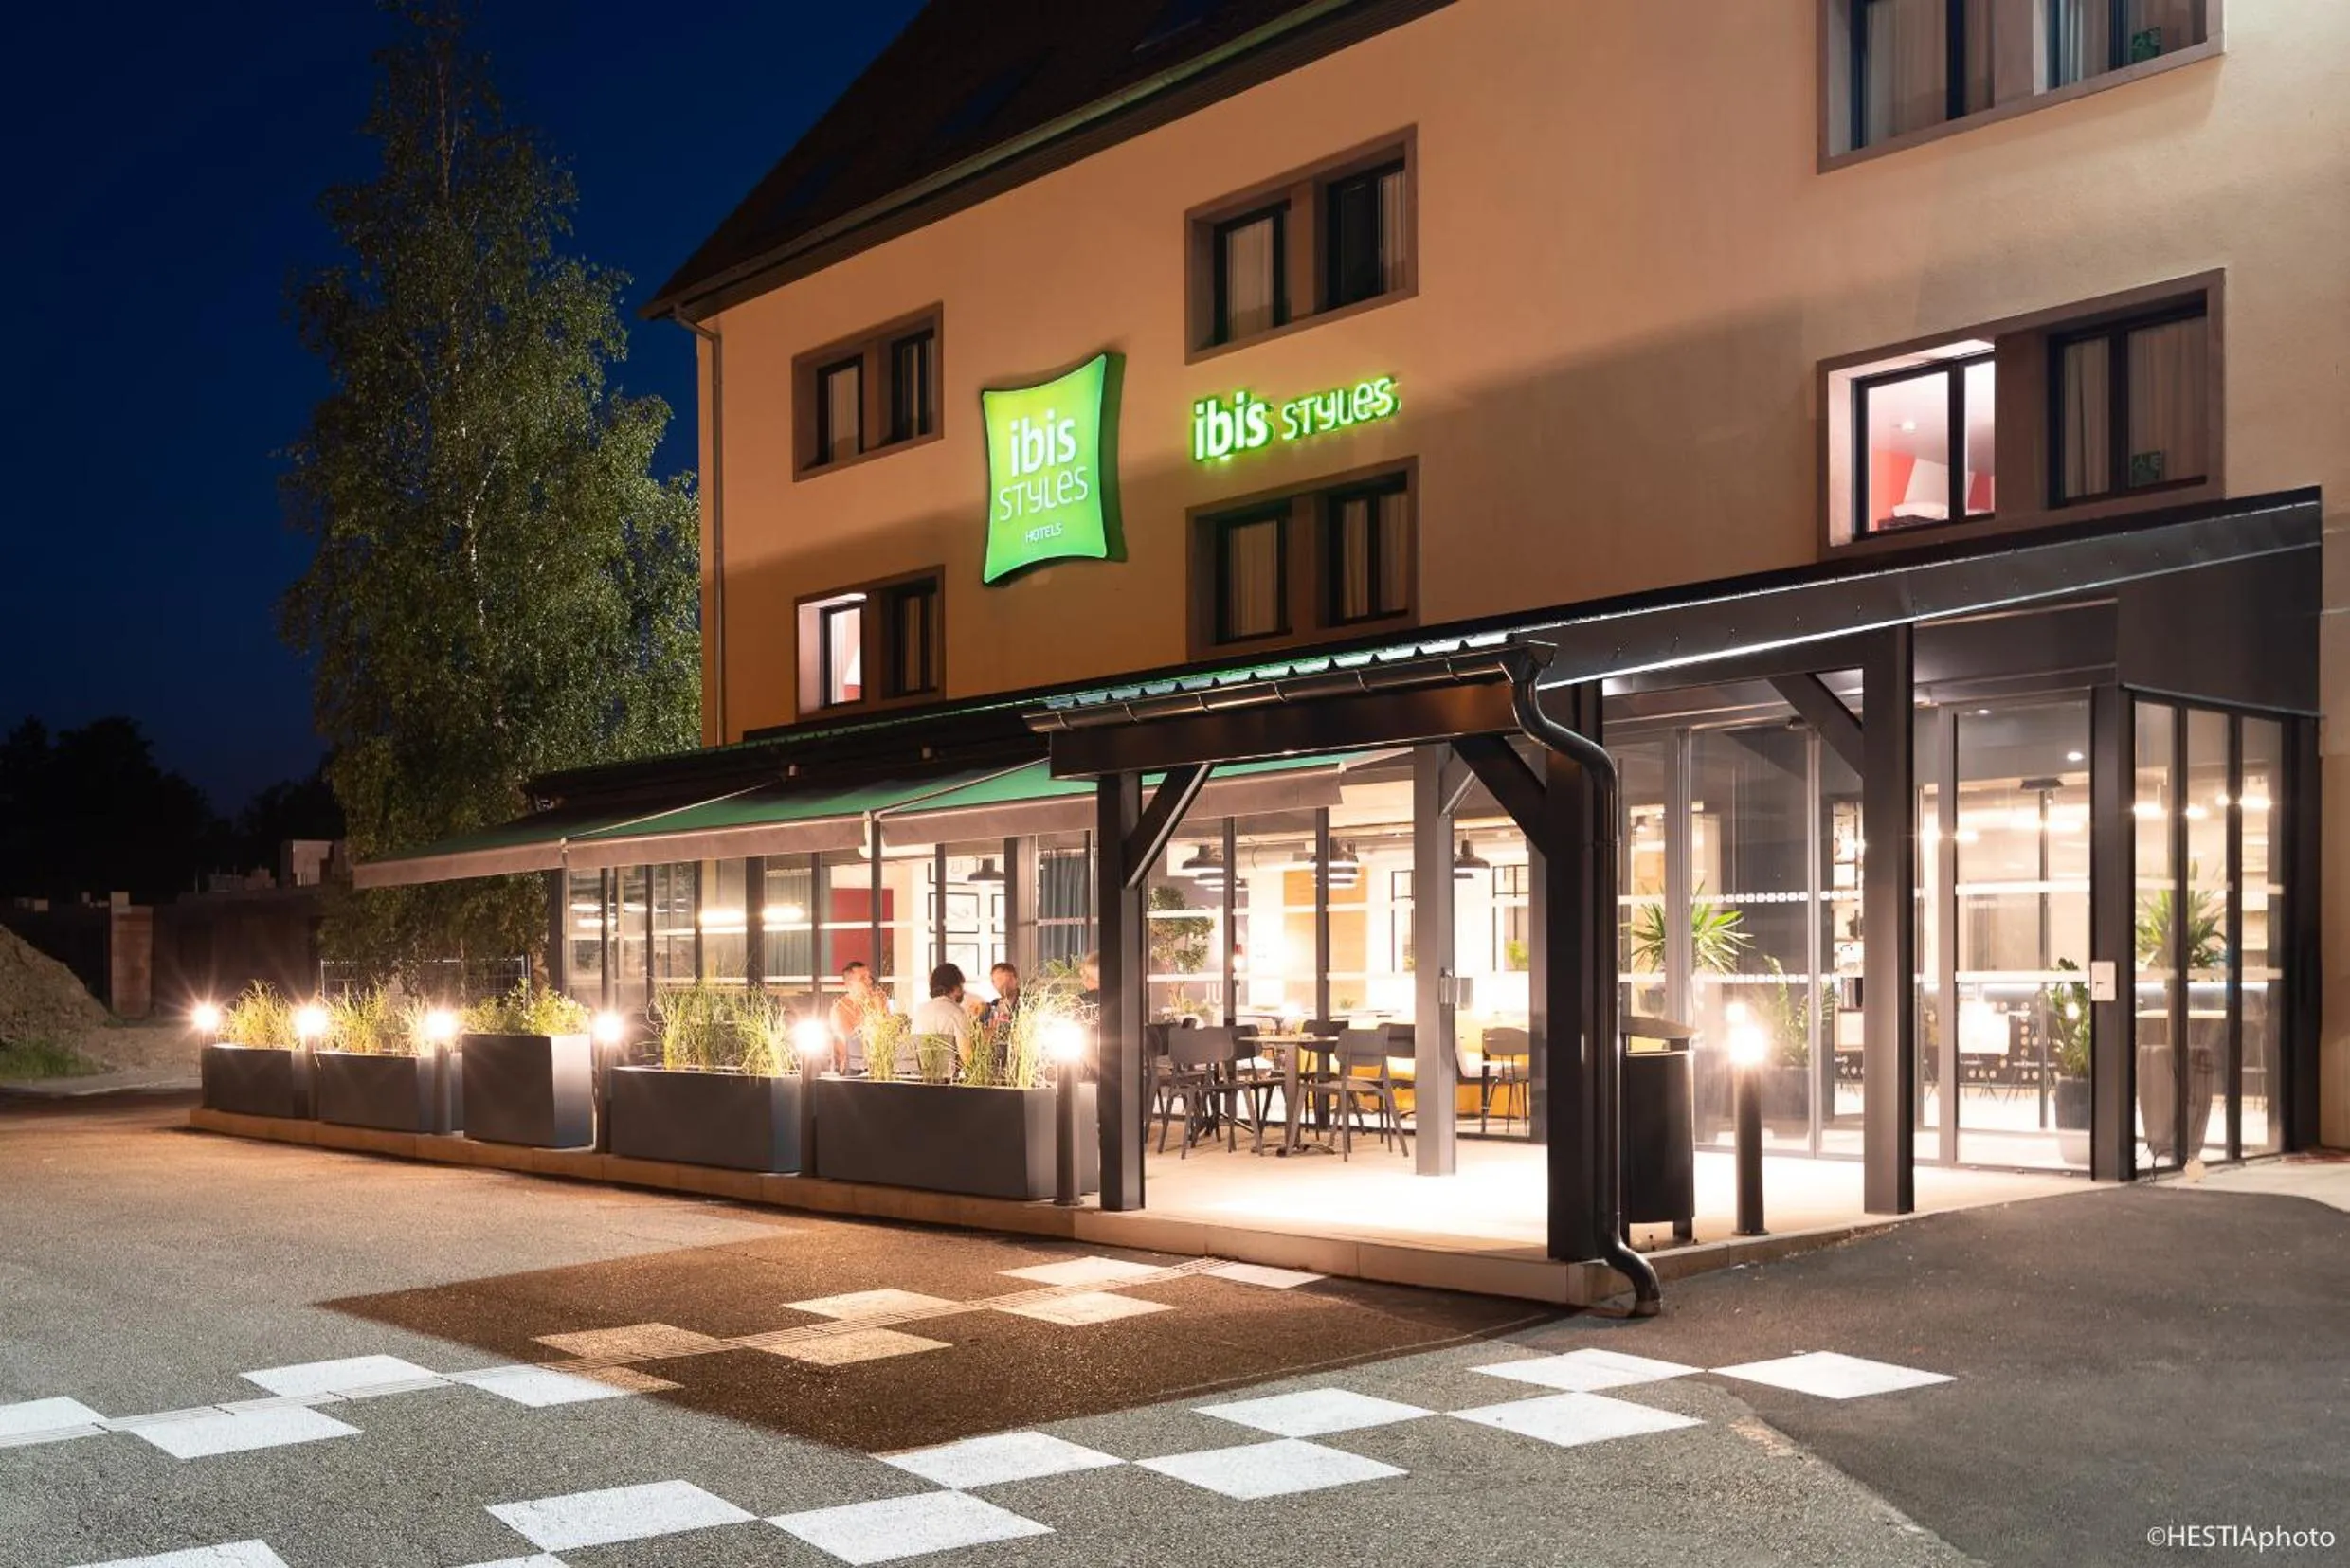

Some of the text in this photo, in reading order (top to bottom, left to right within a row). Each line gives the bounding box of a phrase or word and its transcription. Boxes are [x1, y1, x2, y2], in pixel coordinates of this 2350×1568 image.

[1010, 408, 1076, 477] ibis
[1195, 390, 1269, 460] ibis
[1025, 522, 1063, 543] HOTELS
